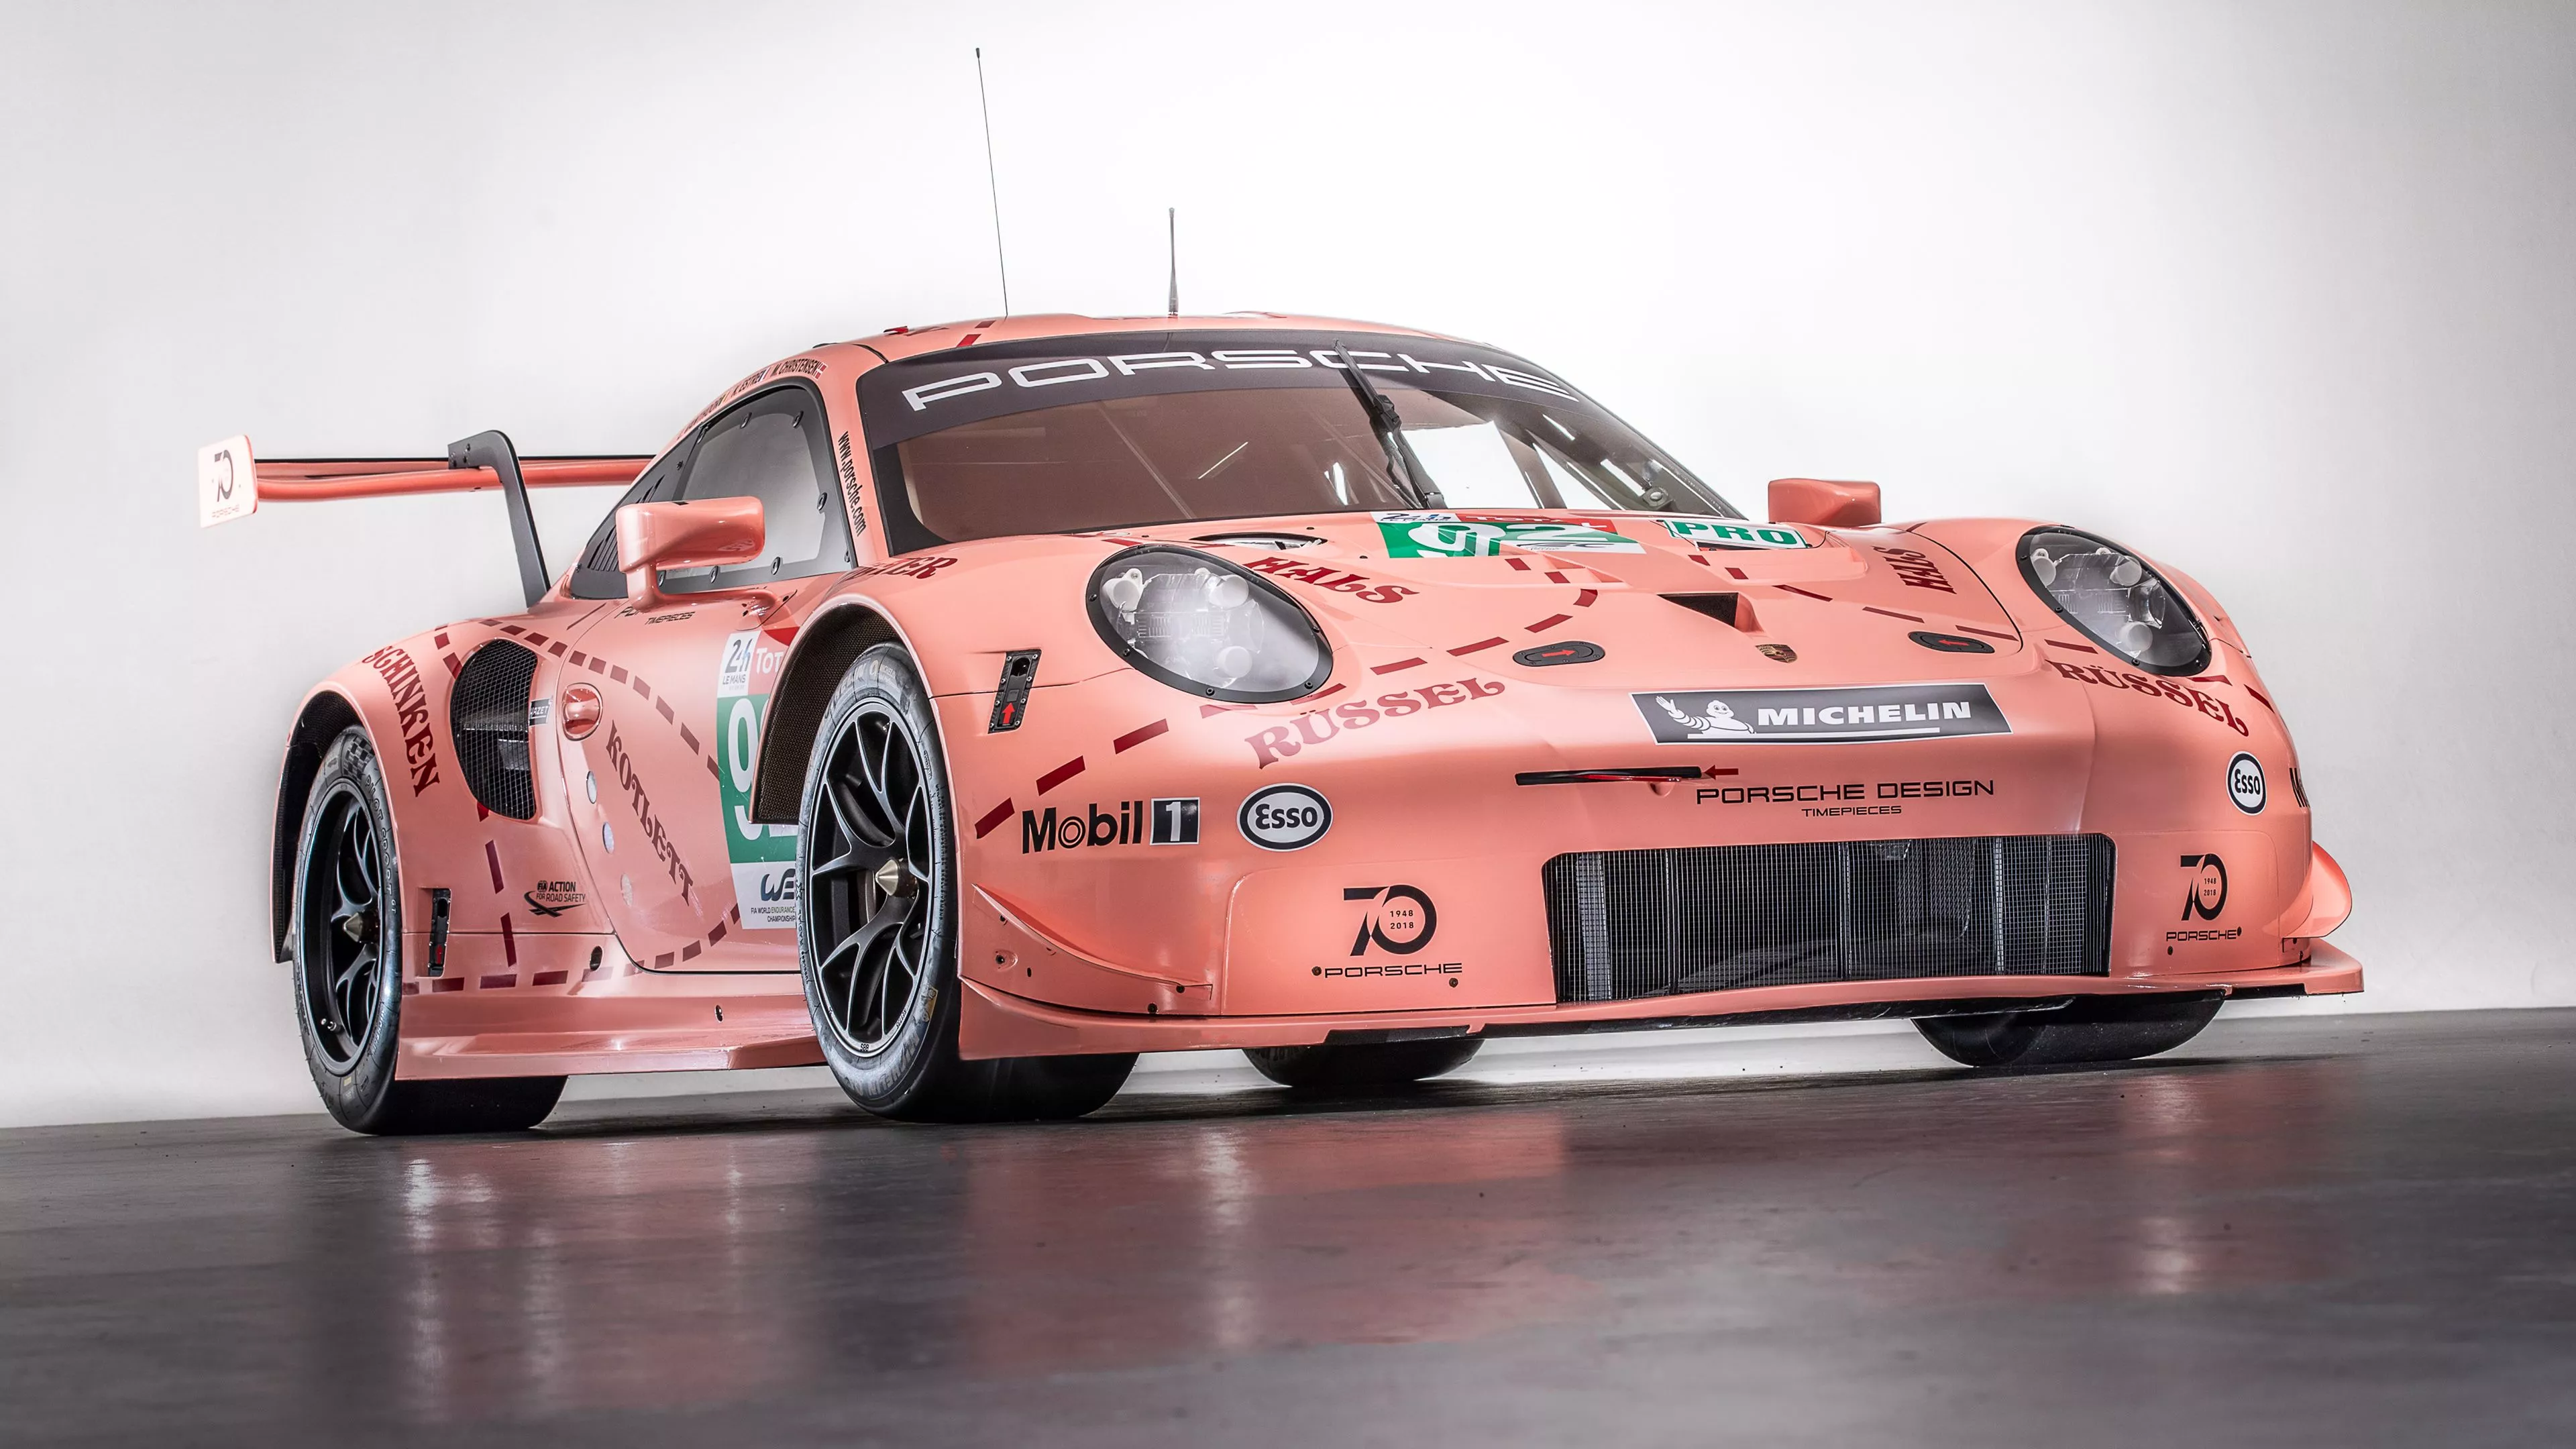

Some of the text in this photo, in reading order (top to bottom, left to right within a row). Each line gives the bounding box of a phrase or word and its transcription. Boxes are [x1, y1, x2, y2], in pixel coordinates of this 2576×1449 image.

[779, 358, 820, 376] CHRISTENSEN
[902, 350, 1580, 411] PORSCHE
[838, 431, 867, 537] www.porsche.com
[1409, 523, 1609, 557] 92
[1671, 521, 1798, 545] PRO
[1242, 557, 1420, 603] HALS
[1871, 545, 1957, 595] HALS
[645, 611, 696, 625] TIMEPIECES
[722, 674, 746, 685] LE MANS
[1757, 701, 1972, 727] MICHELIN
[2044, 659, 2249, 737] RÜSSEL
[362, 645, 440, 798] SCHINKEN
[1244, 678, 1505, 769] RÜSSEL
[728, 698, 798, 840] 9
[364, 774, 384, 821] PILOT
[1696, 780, 1994, 805] PORSCHE DESIGN
[606, 720, 694, 906] KOTLETT
[1022, 801, 1143, 854] Mobil
[1801, 805, 1902, 816] TIMEPIECES
[537, 881, 576, 892] FIA ACTION
[546, 893, 563, 902] ROAD
[564, 893, 586, 902] SAFETY
[2180, 853, 2228, 921] 70
[757, 906, 771, 914] WORLD
[1343, 884, 1437, 957] 70
[1390, 922, 1414, 930] 2018
[2166, 929, 2237, 942] PORSCHE
[1325, 963, 1462, 979] PORSCHE
